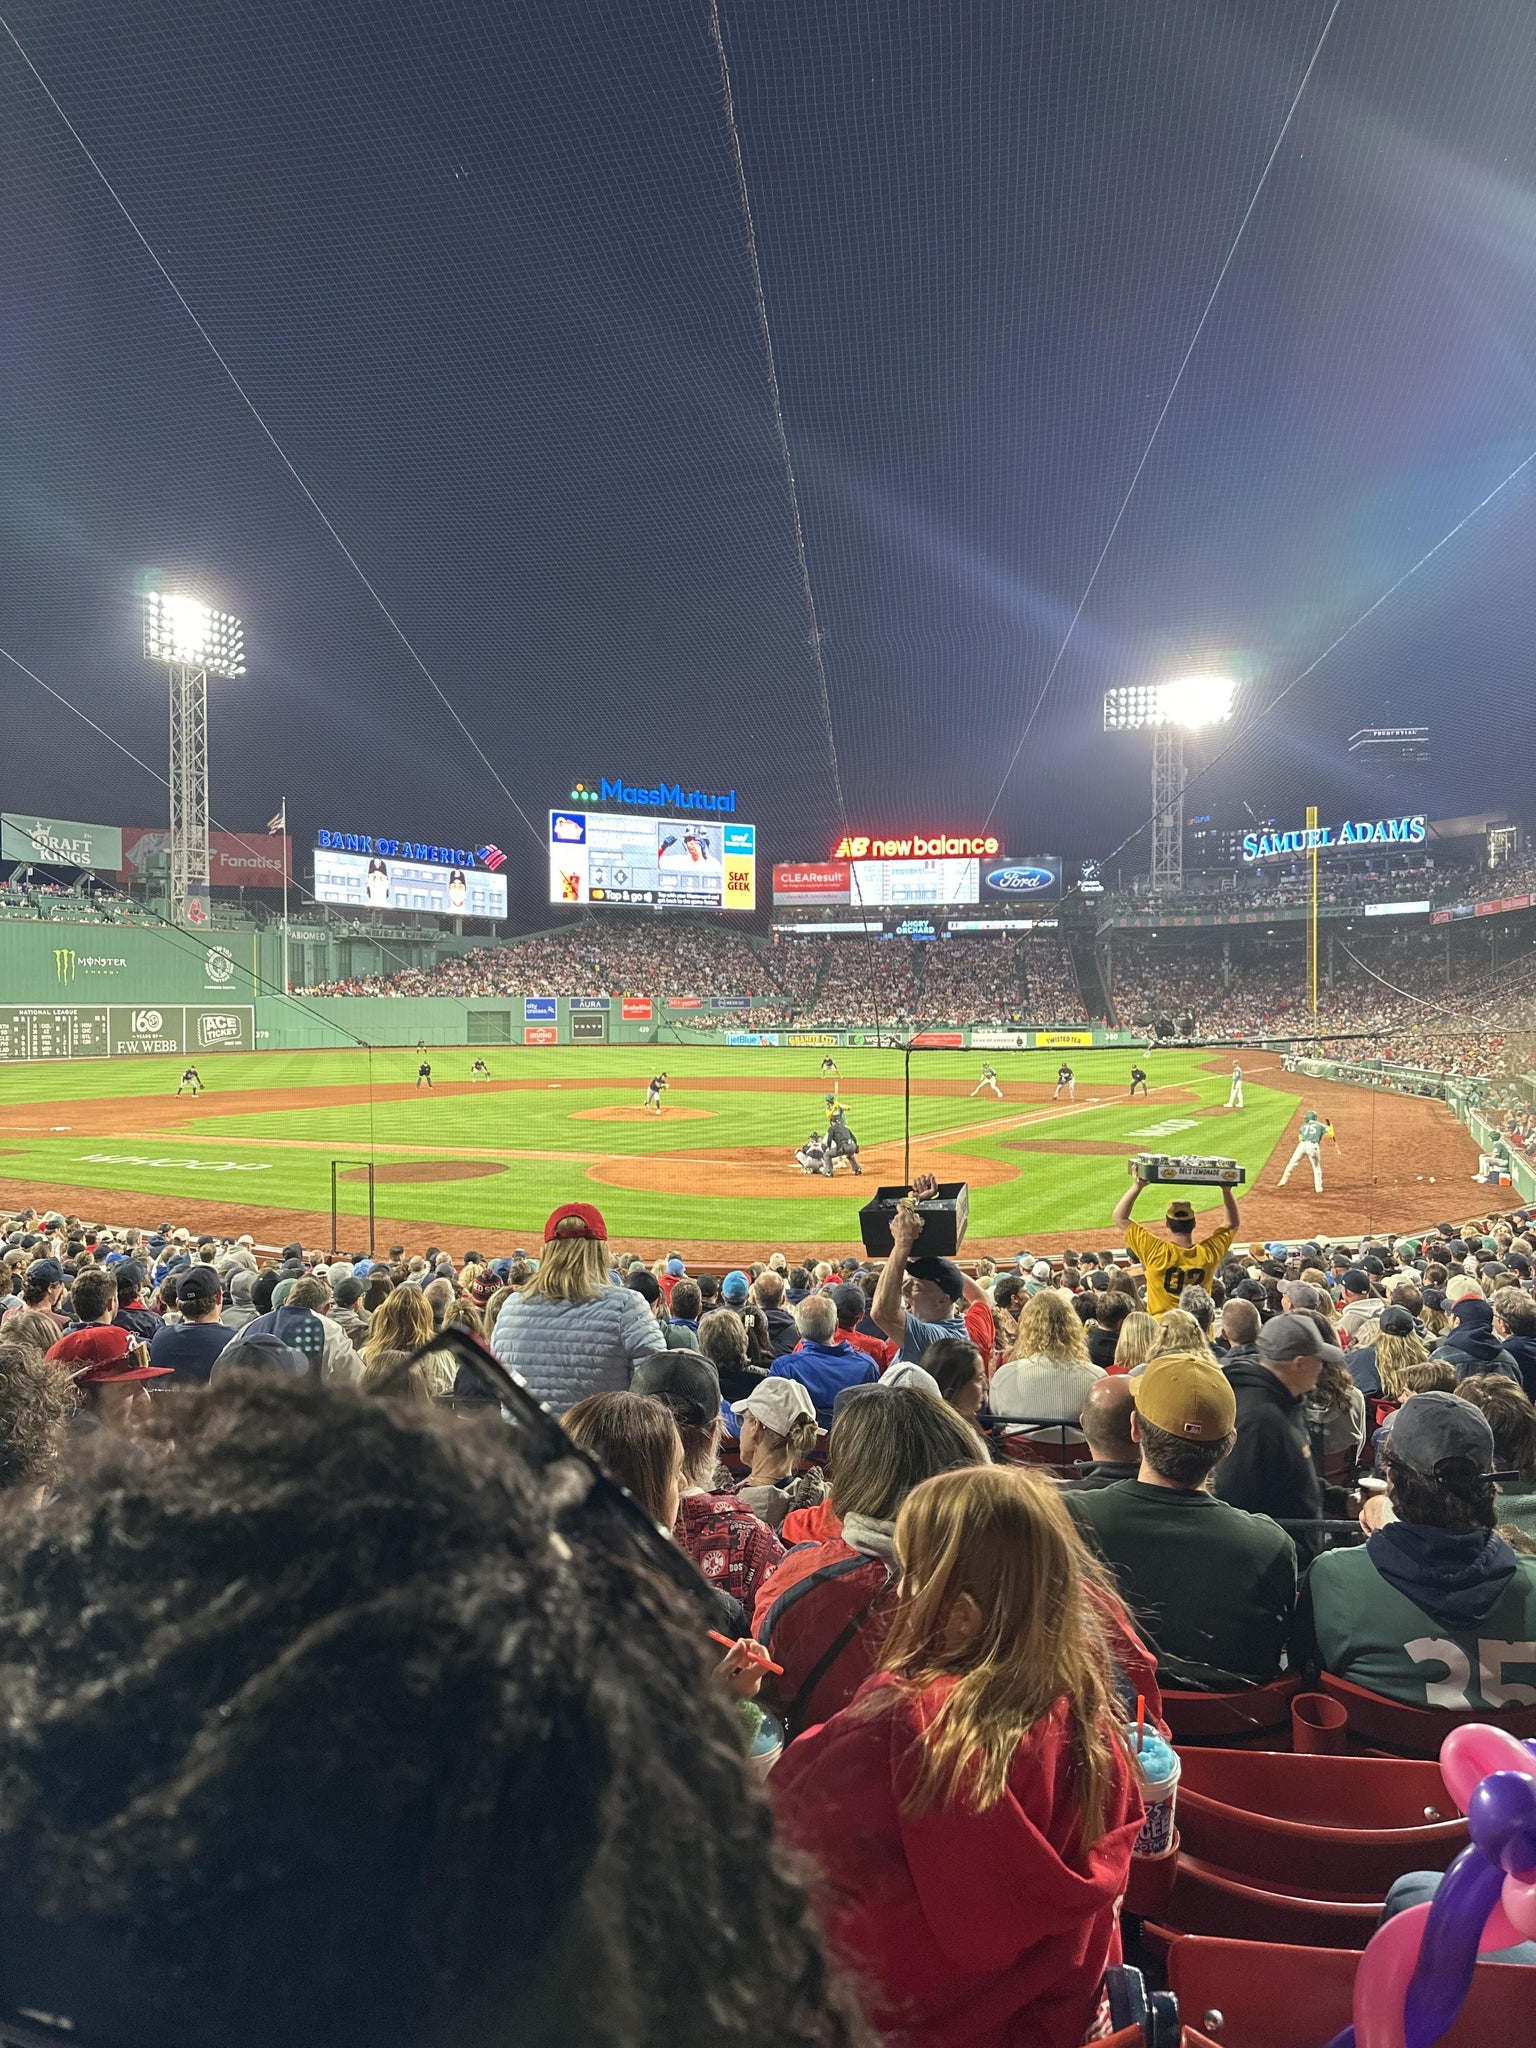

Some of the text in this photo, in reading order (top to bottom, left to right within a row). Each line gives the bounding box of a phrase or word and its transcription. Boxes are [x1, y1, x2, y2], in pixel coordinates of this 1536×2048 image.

[601, 777, 736, 812] MassMutual
[31, 835, 92, 853] DRAFT
[913, 834, 999, 855] balance
[1243, 816, 1427, 861] SAMUEL ADAMS
[318, 829, 477, 868] BANK OF AMERICA
[40, 850, 91, 865] KINGS
[220, 853, 281, 869] Fanatics
[728, 872, 749, 881] SEAT
[781, 873, 842, 883] CLEAResult
[1000, 870, 1040, 888] Ford
[728, 882, 750, 892] GEEK
[605, 890, 643, 903] Tap & go
[291, 931, 326, 940] ABIOMED
[895, 926, 935, 935] ORCHARD
[77, 956, 127, 967] MONSTER
[131, 1010, 163, 1033] 160
[206, 1016, 237, 1031] ACE
[206, 1028, 237, 1041] TICKET
[730, 1036, 757, 1045] jetBlue
[789, 1034, 837, 1045] GRANITE CITY
[1046, 1036, 1081, 1045] TWISTED TEA
[1105, 1033, 1118, 1041] 380
[117, 1040, 178, 1054] F.W. WEBB
[1303, 1124, 1317, 1135] 75
[71, 1153, 273, 1171] WHOOP
[1193, 1168, 1220, 1177] LEMONADE
[729, 1563, 744, 1572] BOS
[1403, 1637, 1536, 1712] 35
